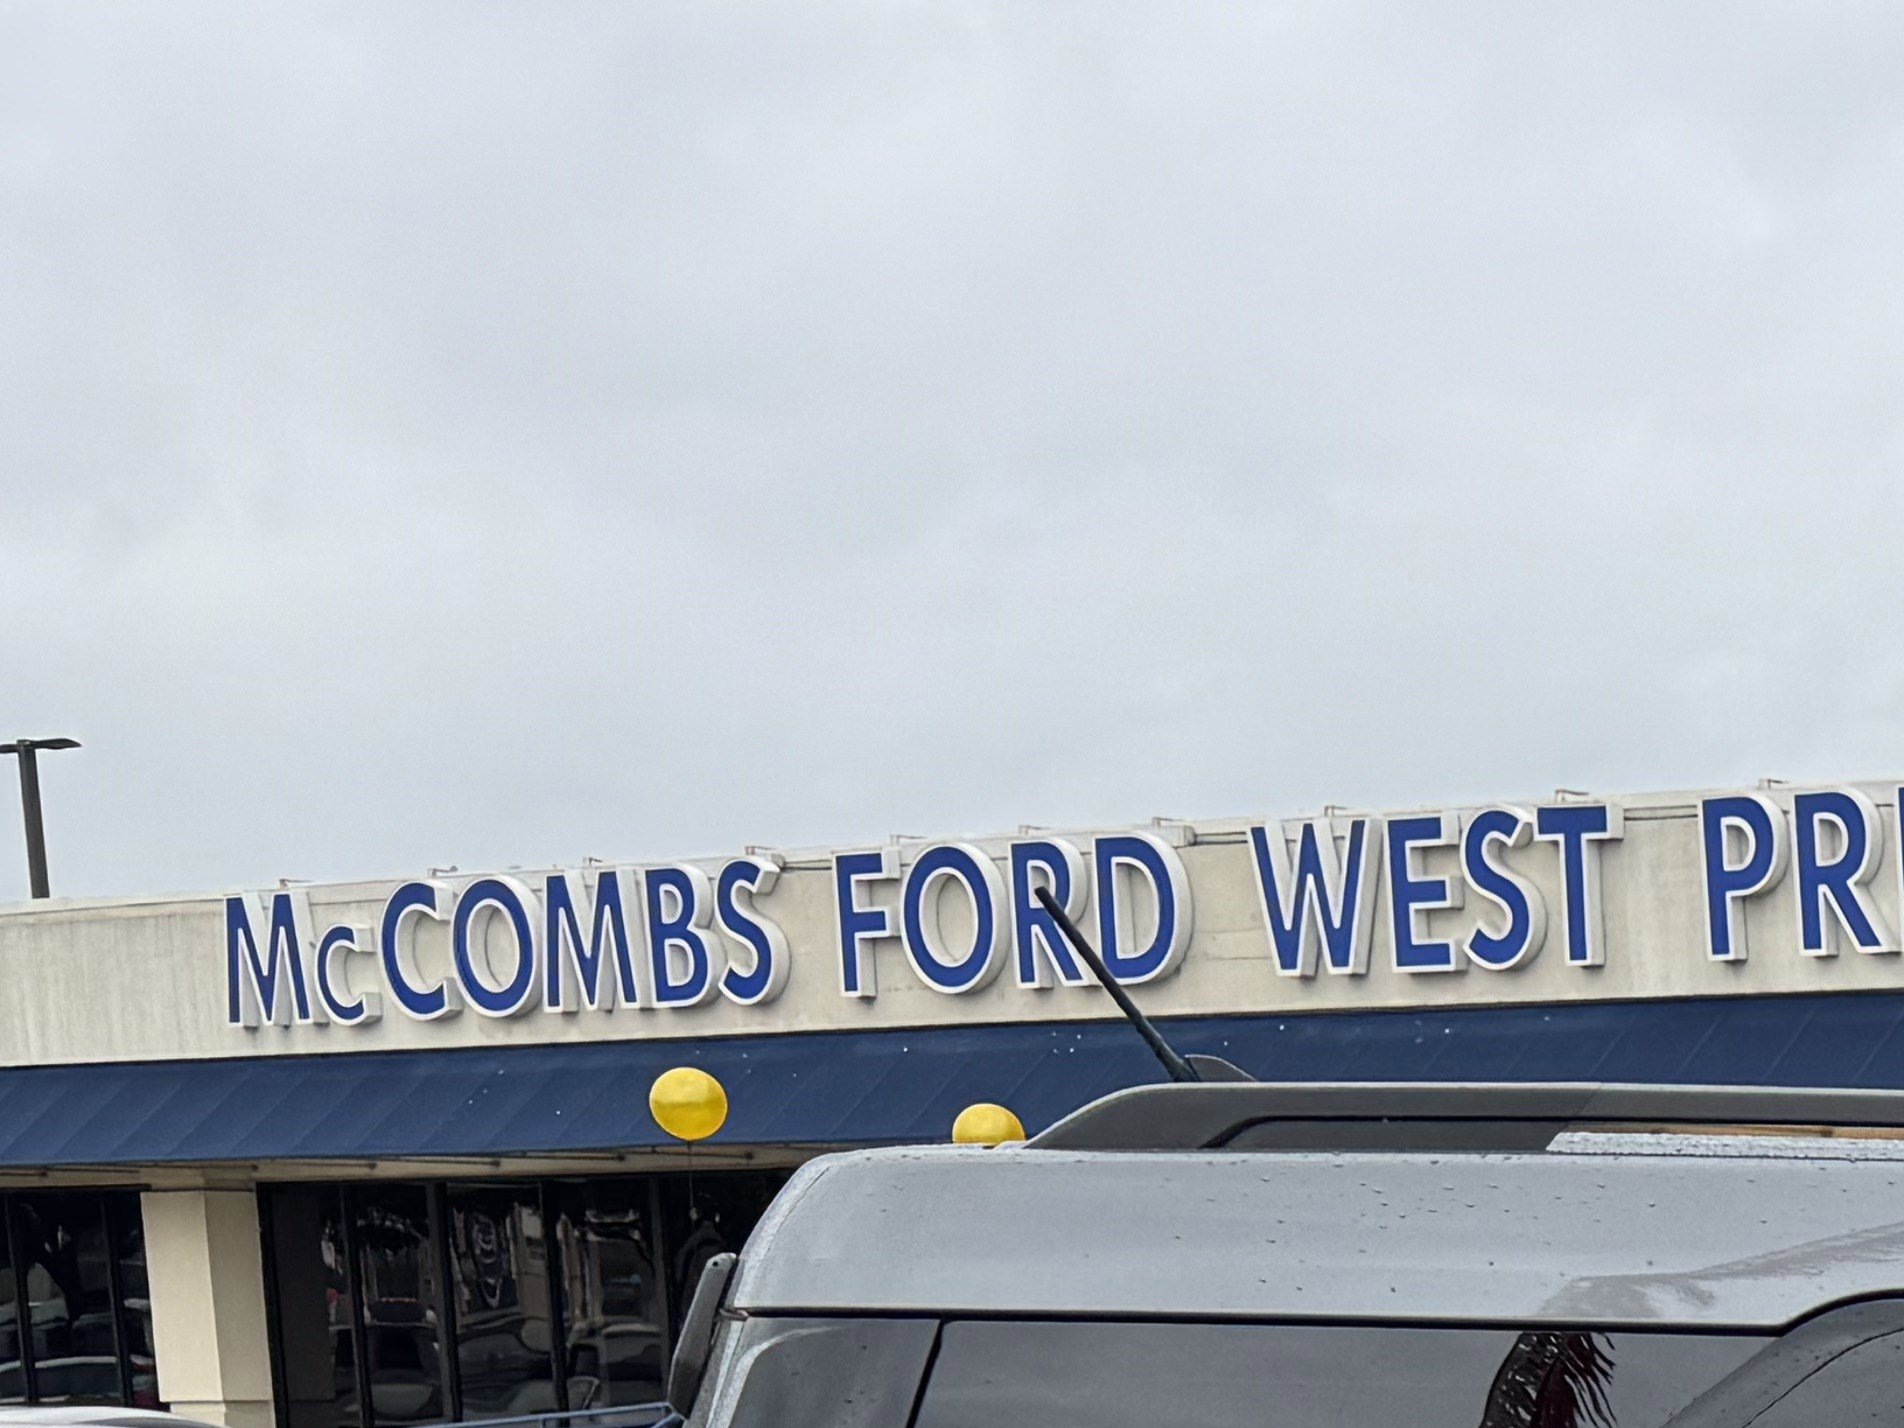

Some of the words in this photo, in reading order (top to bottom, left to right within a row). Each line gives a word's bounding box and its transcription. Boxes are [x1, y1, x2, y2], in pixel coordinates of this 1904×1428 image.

[222, 854, 784, 1030] McCOMBS
[832, 830, 1188, 1000] FORD
[1246, 800, 1612, 978] WEST
